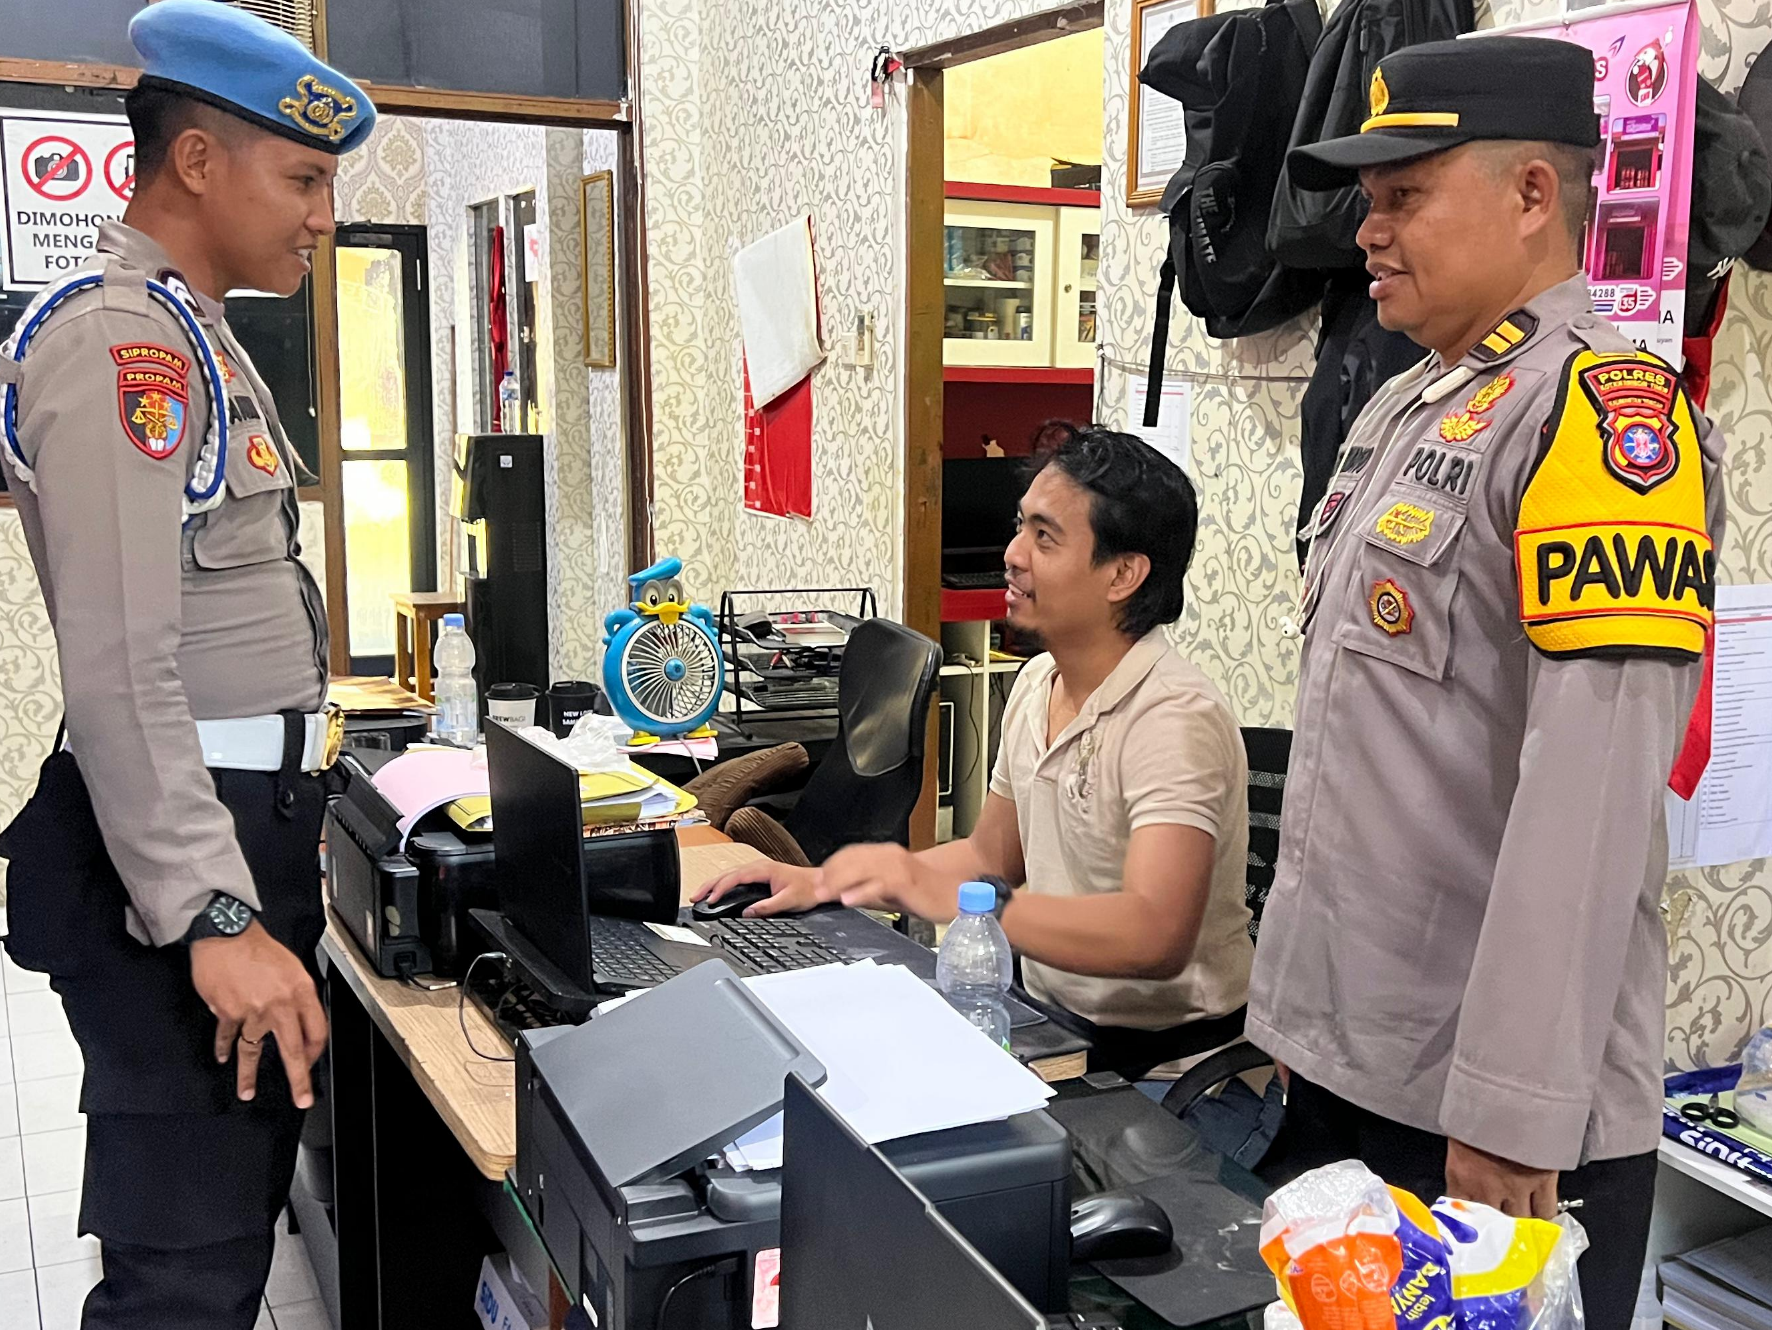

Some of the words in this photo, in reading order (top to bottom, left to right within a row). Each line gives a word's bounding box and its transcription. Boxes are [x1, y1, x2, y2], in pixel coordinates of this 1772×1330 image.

[45, 255, 90, 270] FOT
[120, 347, 183, 369] SIPROPAM
[126, 373, 182, 390] PROPAM
[1598, 369, 1666, 385] POLRES
[1402, 446, 1474, 496] POLRI
